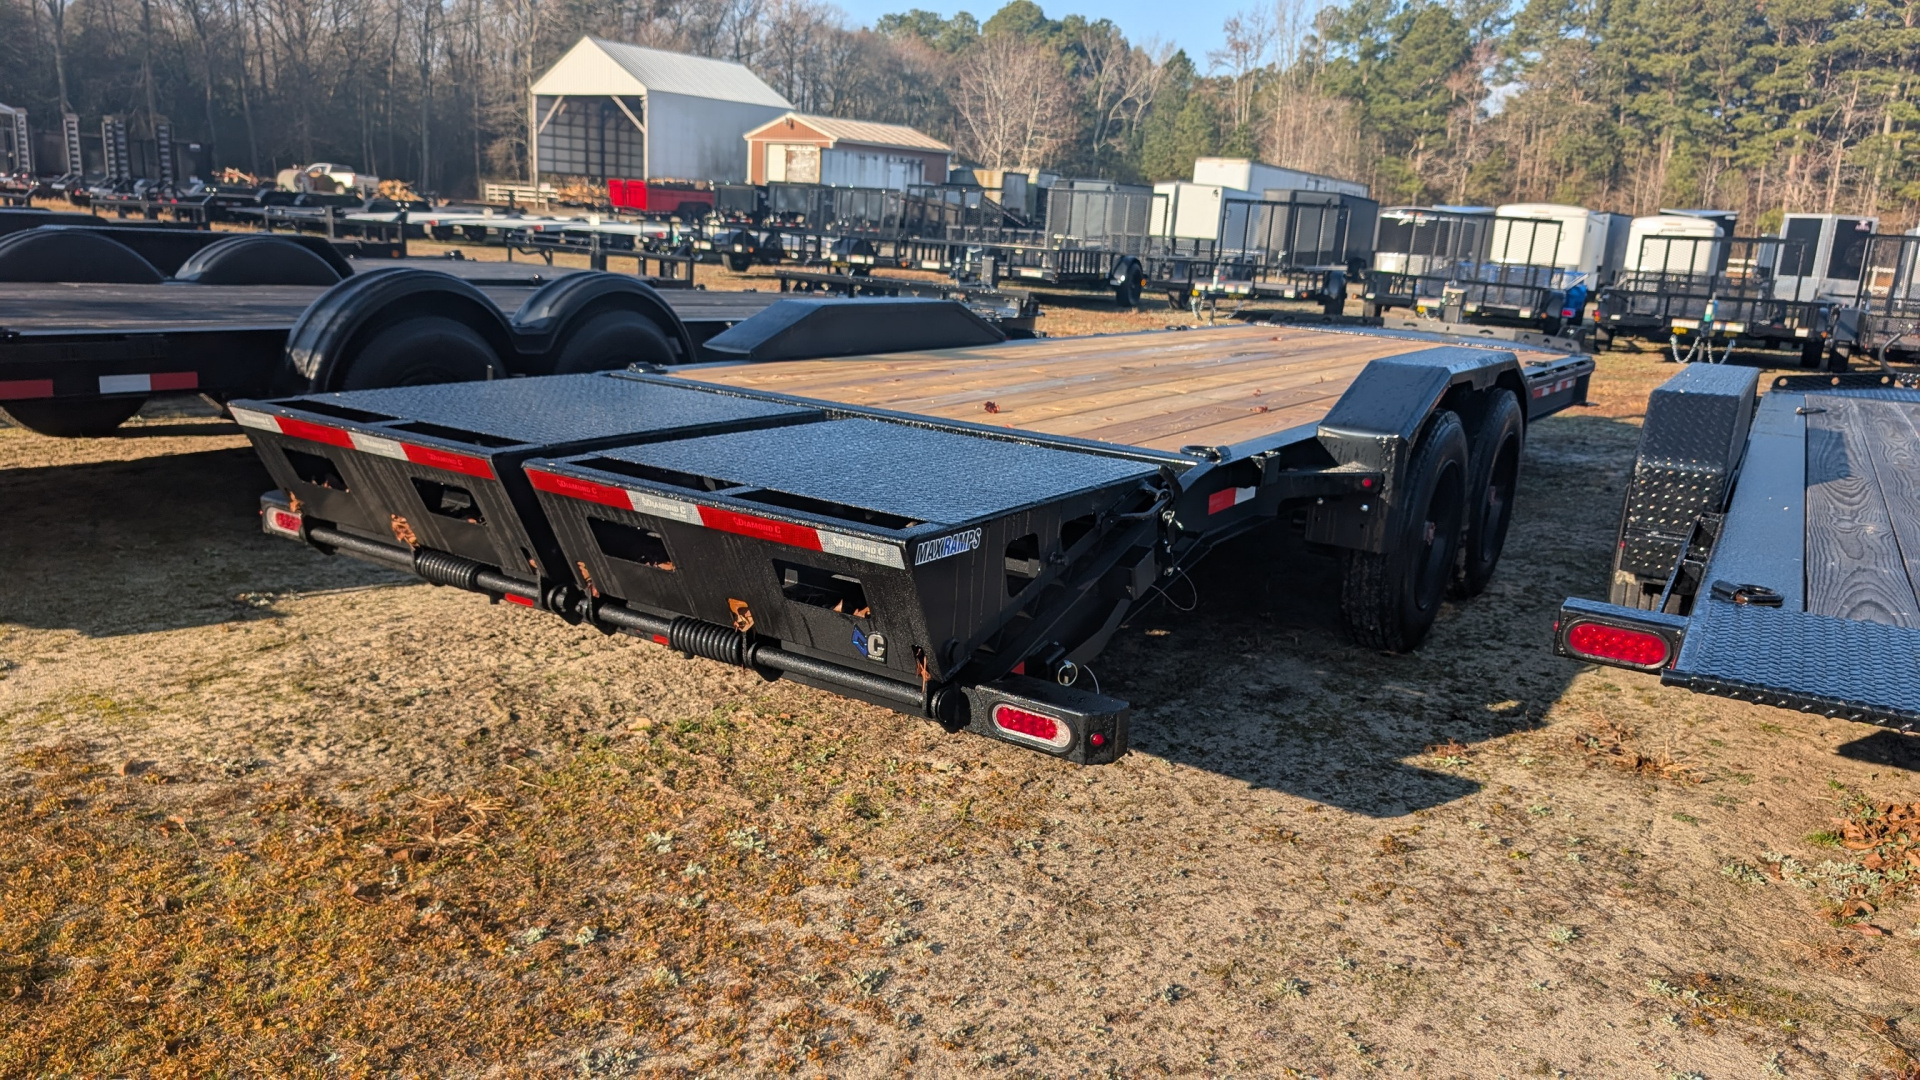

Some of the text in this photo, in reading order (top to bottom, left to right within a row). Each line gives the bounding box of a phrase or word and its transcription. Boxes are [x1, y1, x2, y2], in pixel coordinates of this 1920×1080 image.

[646, 498, 686, 514] DIAMOND C
[737, 518, 781, 534] DIAMOND C
[839, 538, 885, 556] DIAMOND C
